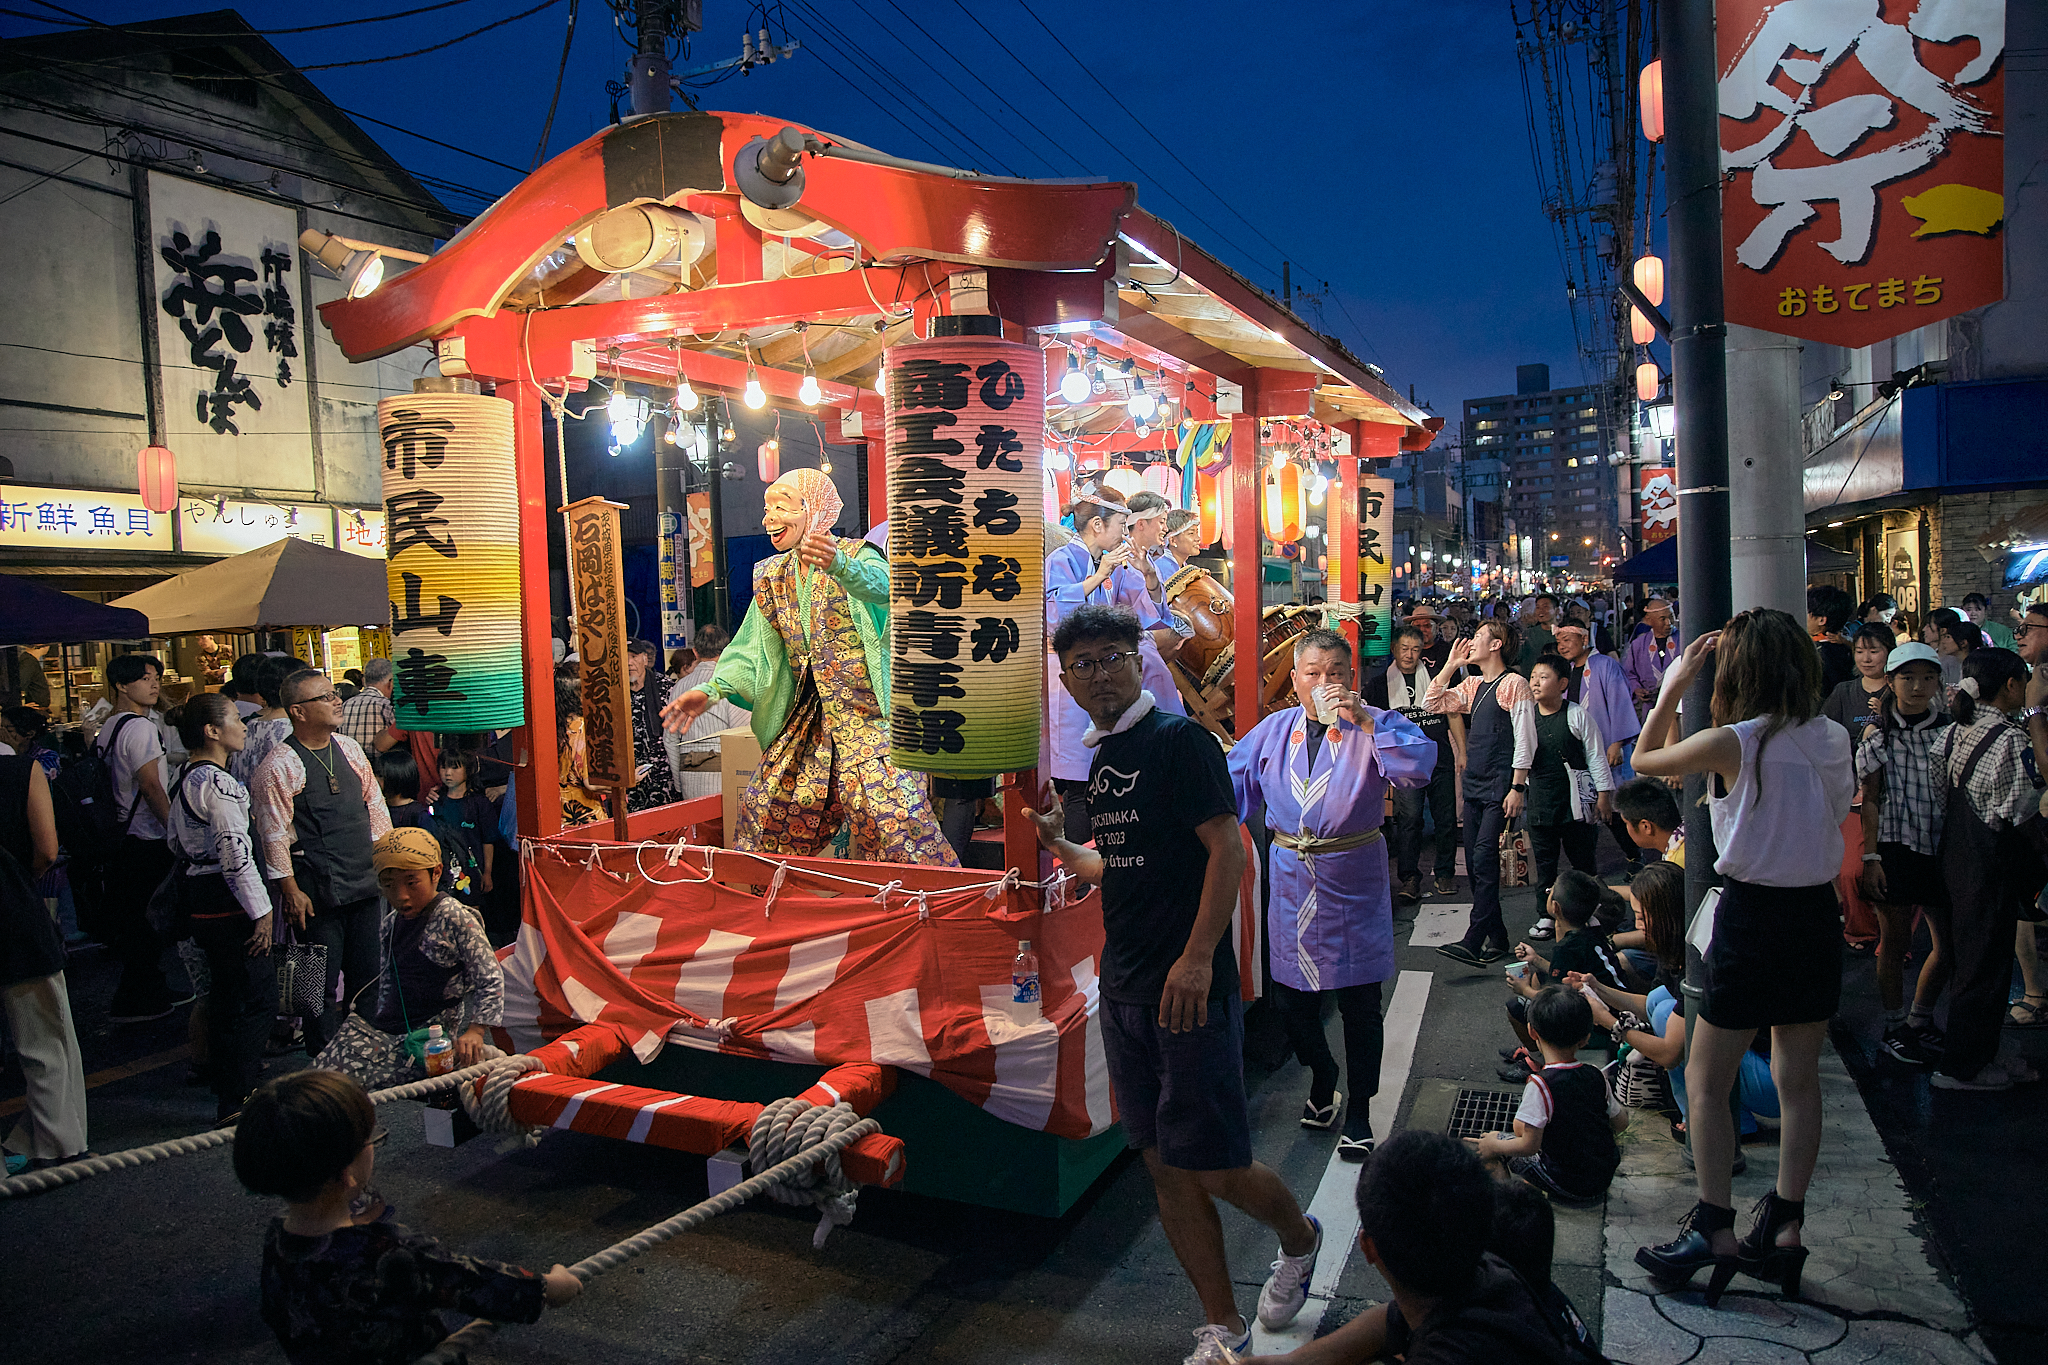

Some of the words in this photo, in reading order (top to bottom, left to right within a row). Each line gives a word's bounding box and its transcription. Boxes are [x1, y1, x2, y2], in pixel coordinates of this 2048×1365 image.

[1716, 0, 2004, 270] 祭
[1776, 274, 1943, 319] おもてまち
[0, 501, 154, 537] 新鮮魚貝
[384, 409, 469, 717] 市民山車
[891, 359, 972, 756] 商工会議所青年部
[972, 359, 1026, 663] ひたちなか
[294, 627, 308, 659] ラムネ
[1104, 831, 1126, 845] 2023
